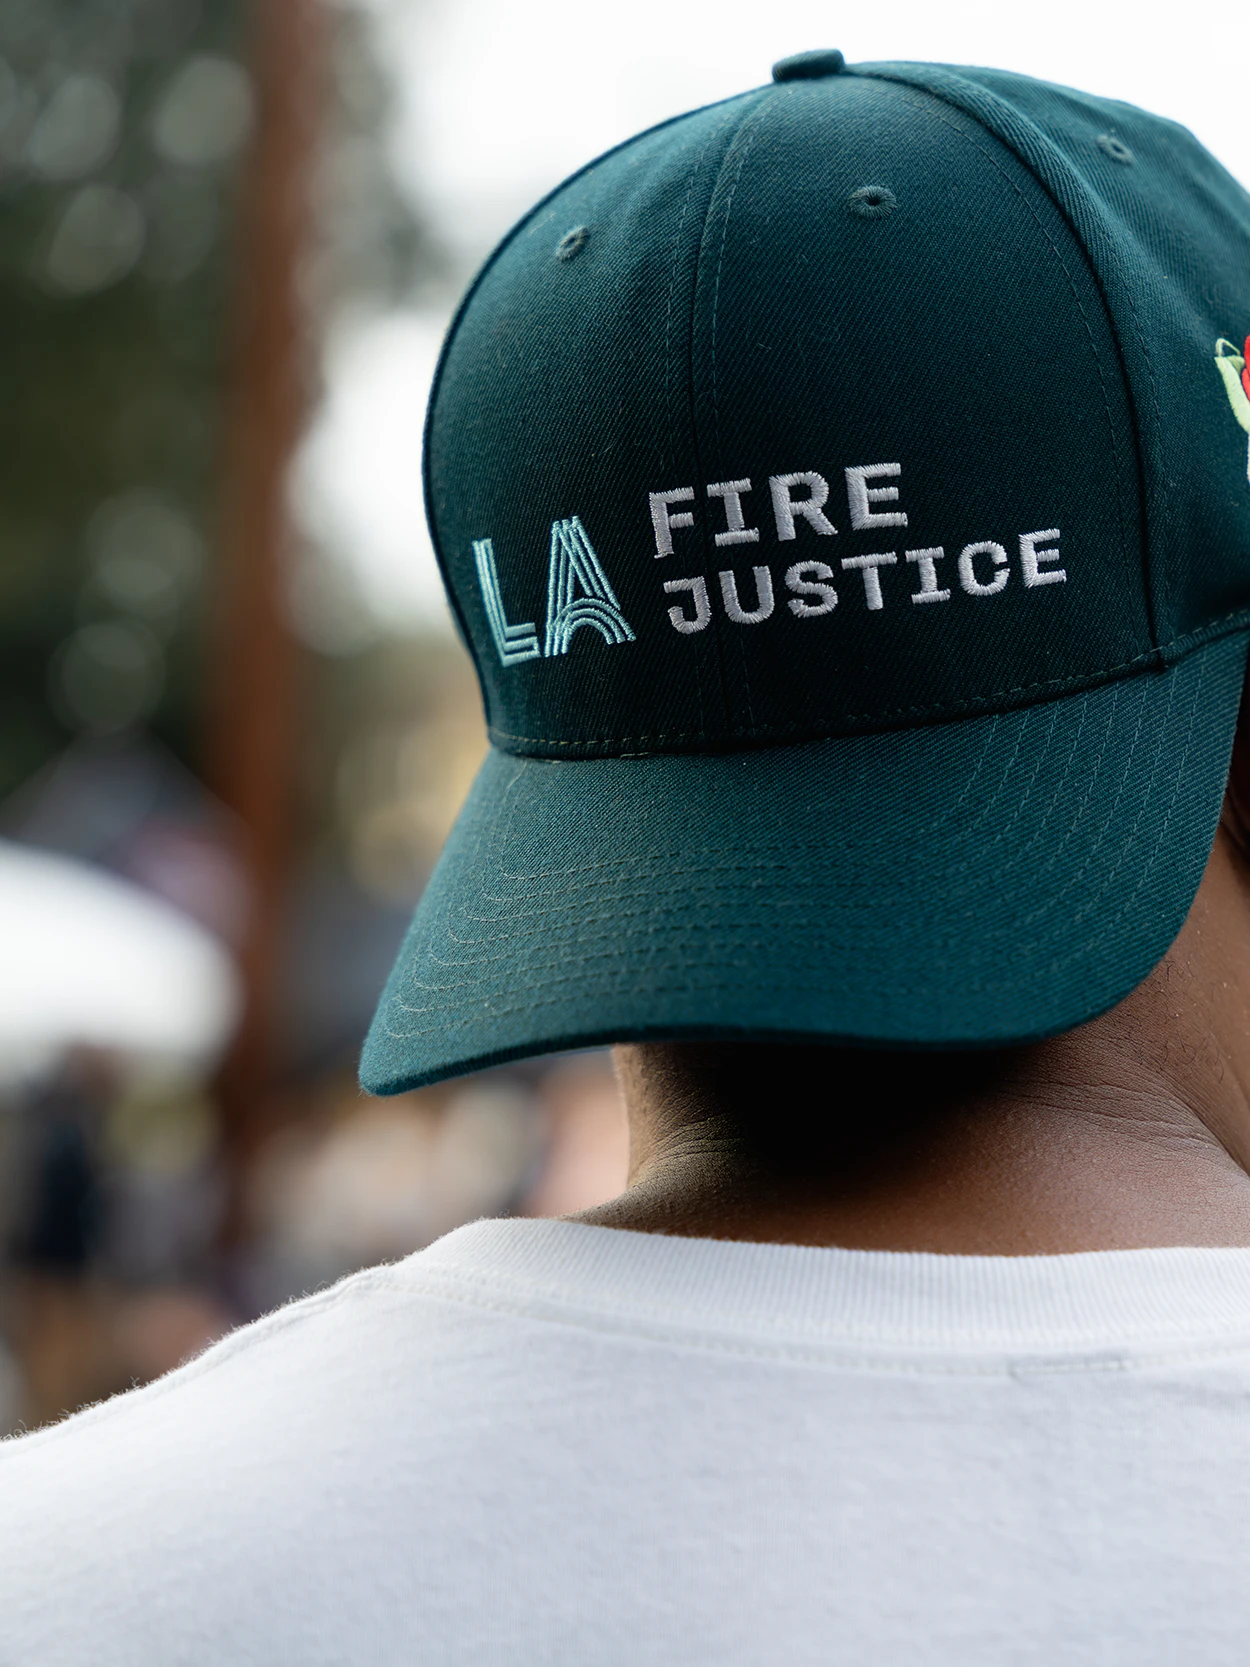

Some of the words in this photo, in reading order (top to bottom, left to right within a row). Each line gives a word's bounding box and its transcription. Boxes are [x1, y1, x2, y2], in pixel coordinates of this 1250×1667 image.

[648, 462, 909, 559] FIRE
[473, 515, 637, 667] LA
[663, 528, 1067, 635] JUSTICE
